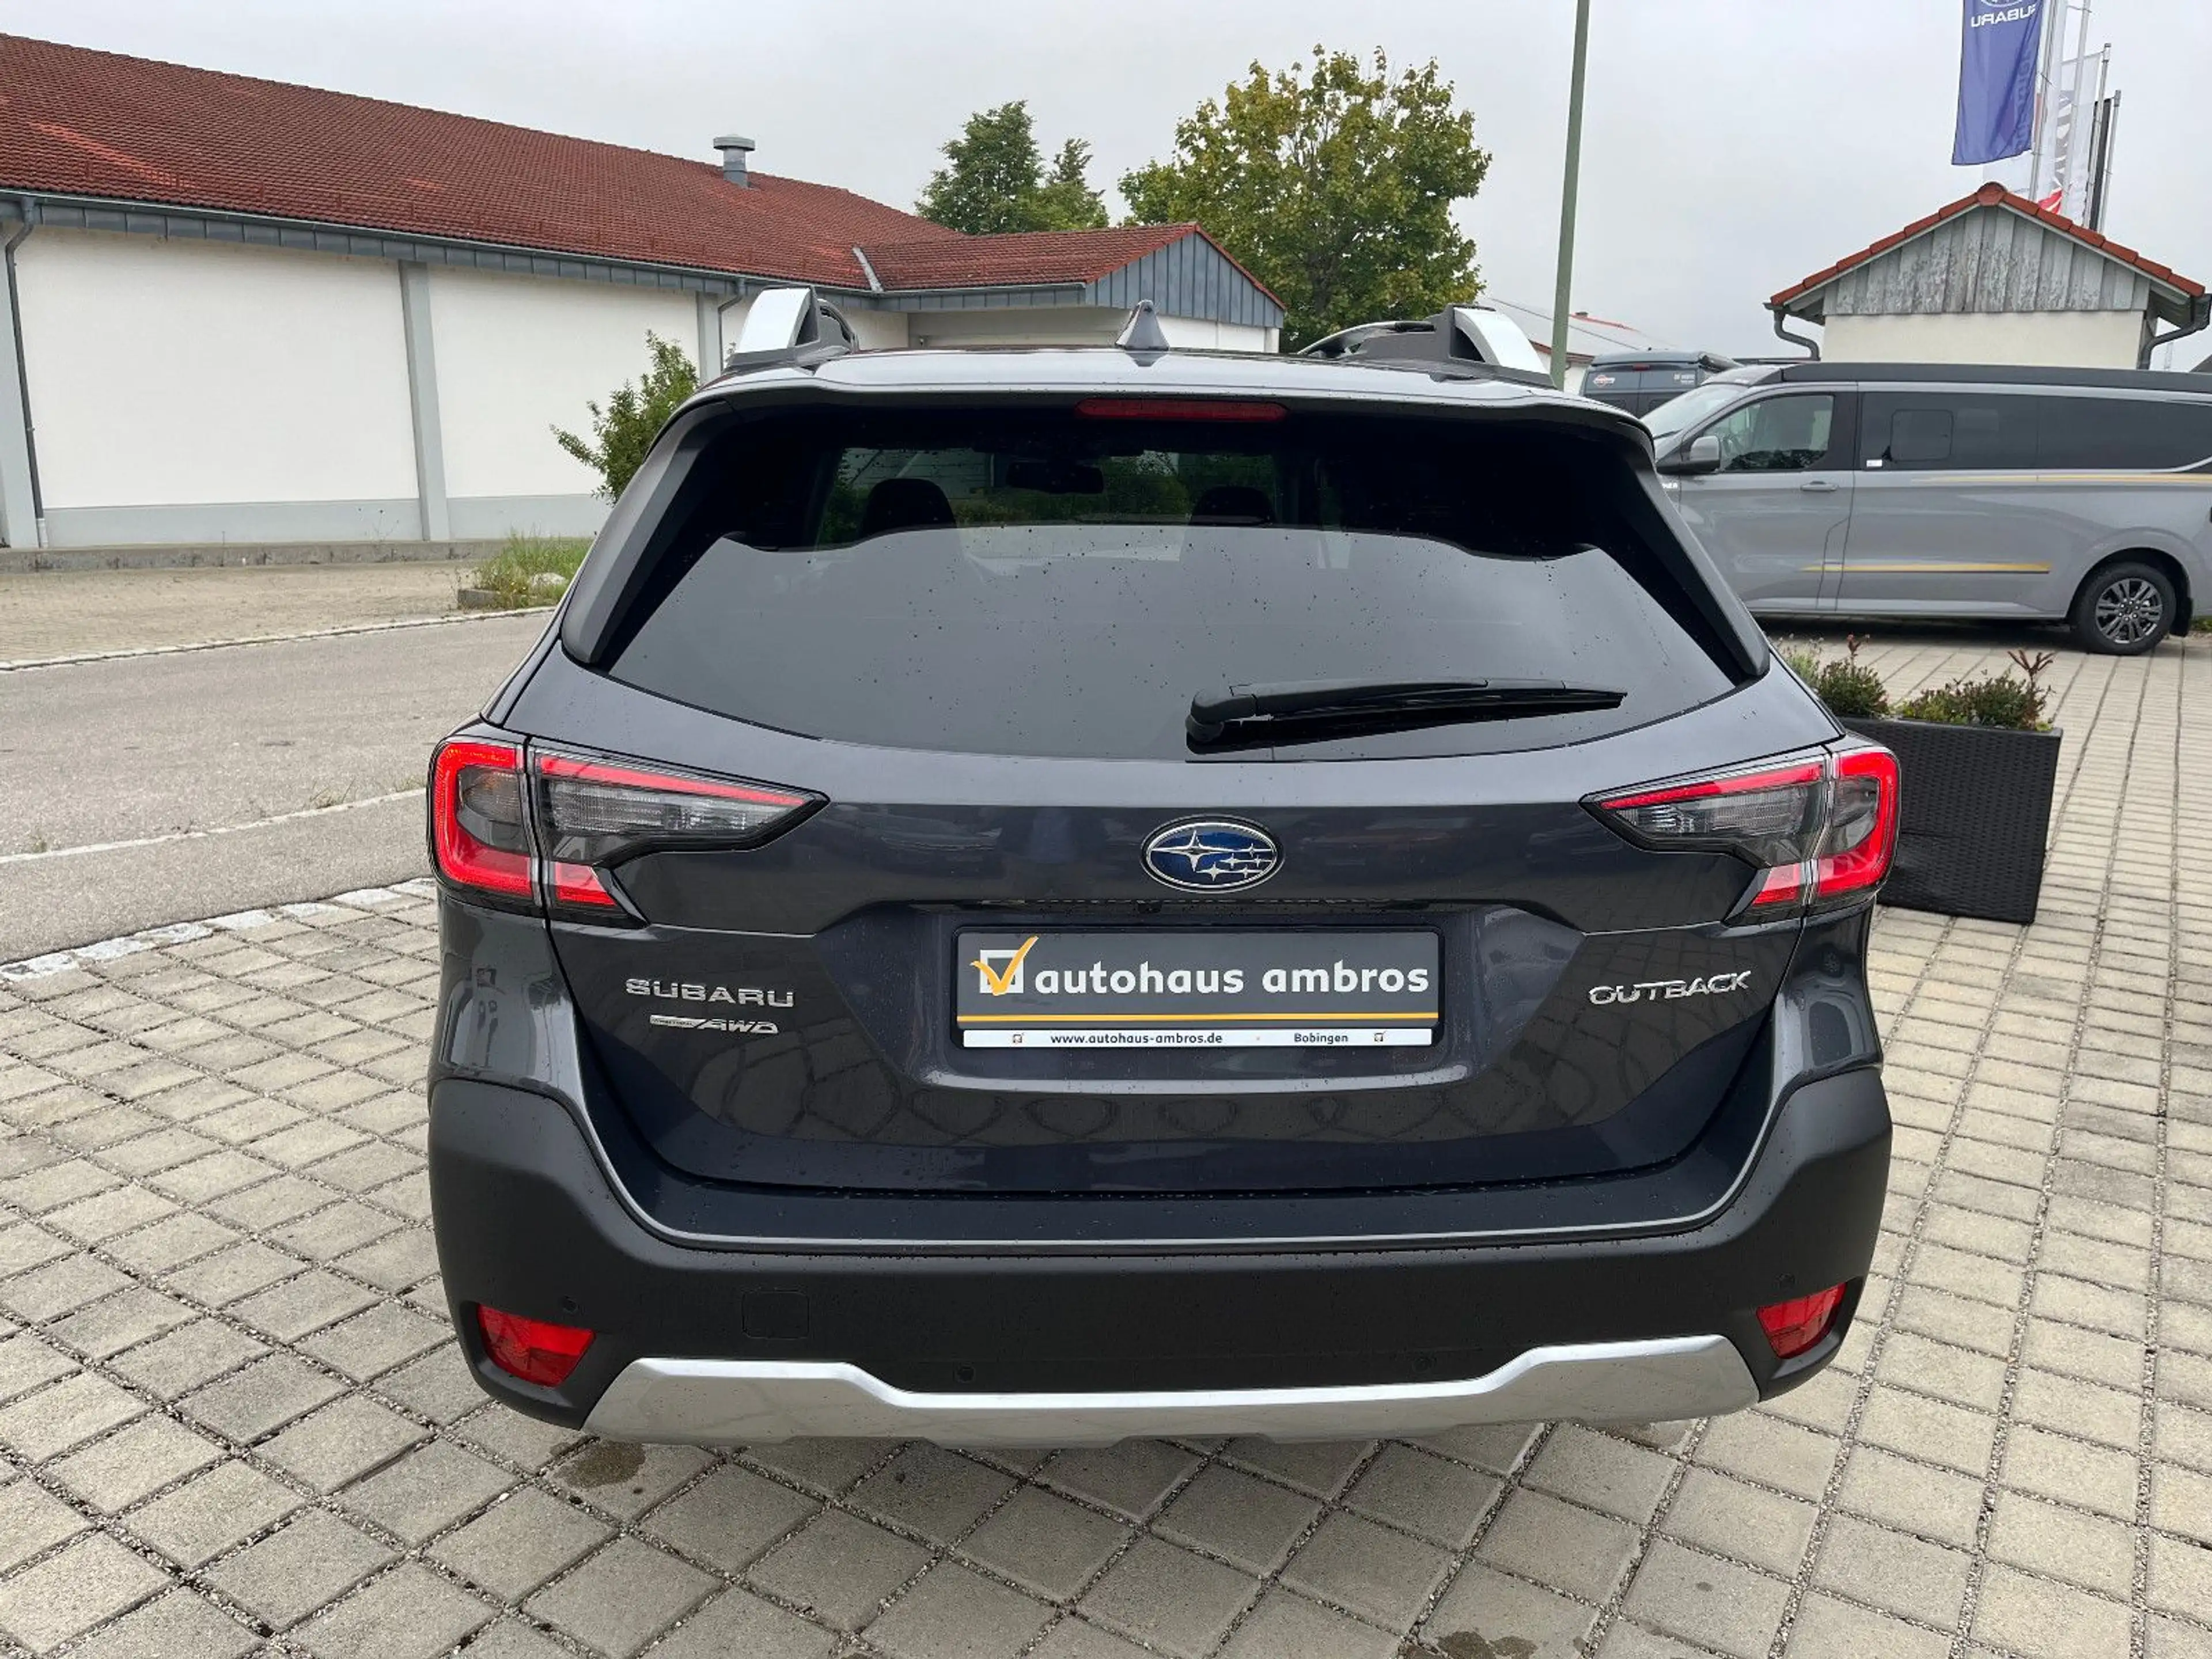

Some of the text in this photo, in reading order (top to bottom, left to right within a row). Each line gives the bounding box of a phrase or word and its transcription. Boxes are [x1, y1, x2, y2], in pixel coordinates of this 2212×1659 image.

[1035, 959, 1429, 994] autohaus ambros
[1588, 970, 1751, 1005] OUTBACK
[625, 978, 794, 1007] SUBARU
[697, 1018, 779, 1034] AWD
[1050, 1031, 1349, 1046] www.autohaus-ambros.de Bobingen
